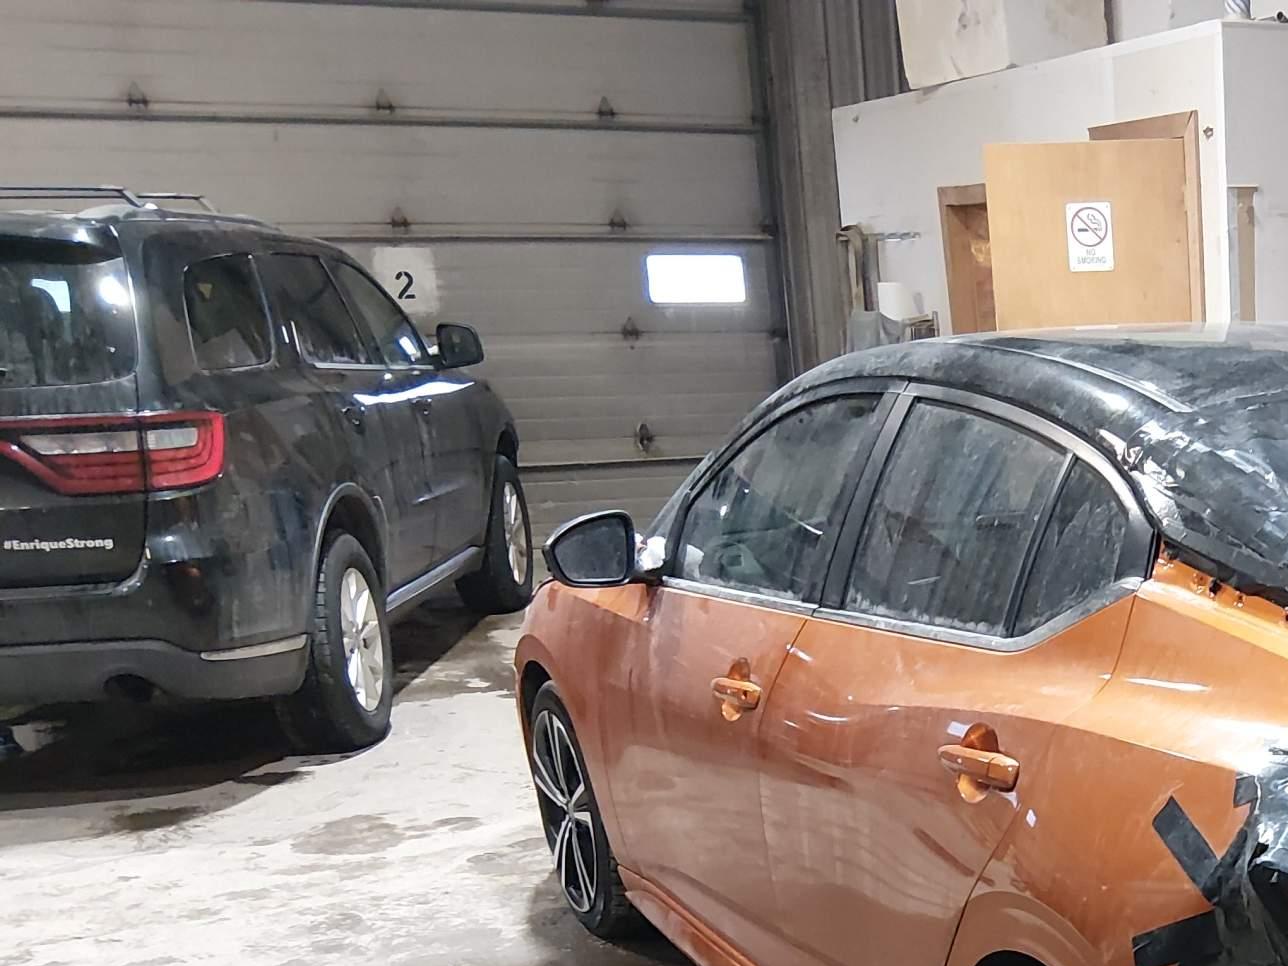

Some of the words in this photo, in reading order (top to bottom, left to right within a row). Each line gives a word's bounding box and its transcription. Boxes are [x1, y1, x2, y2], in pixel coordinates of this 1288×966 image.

[1086, 248, 1096, 256] NO
[395, 271, 416, 299] 2
[3, 538, 114, 552] #EnriqueStrong
